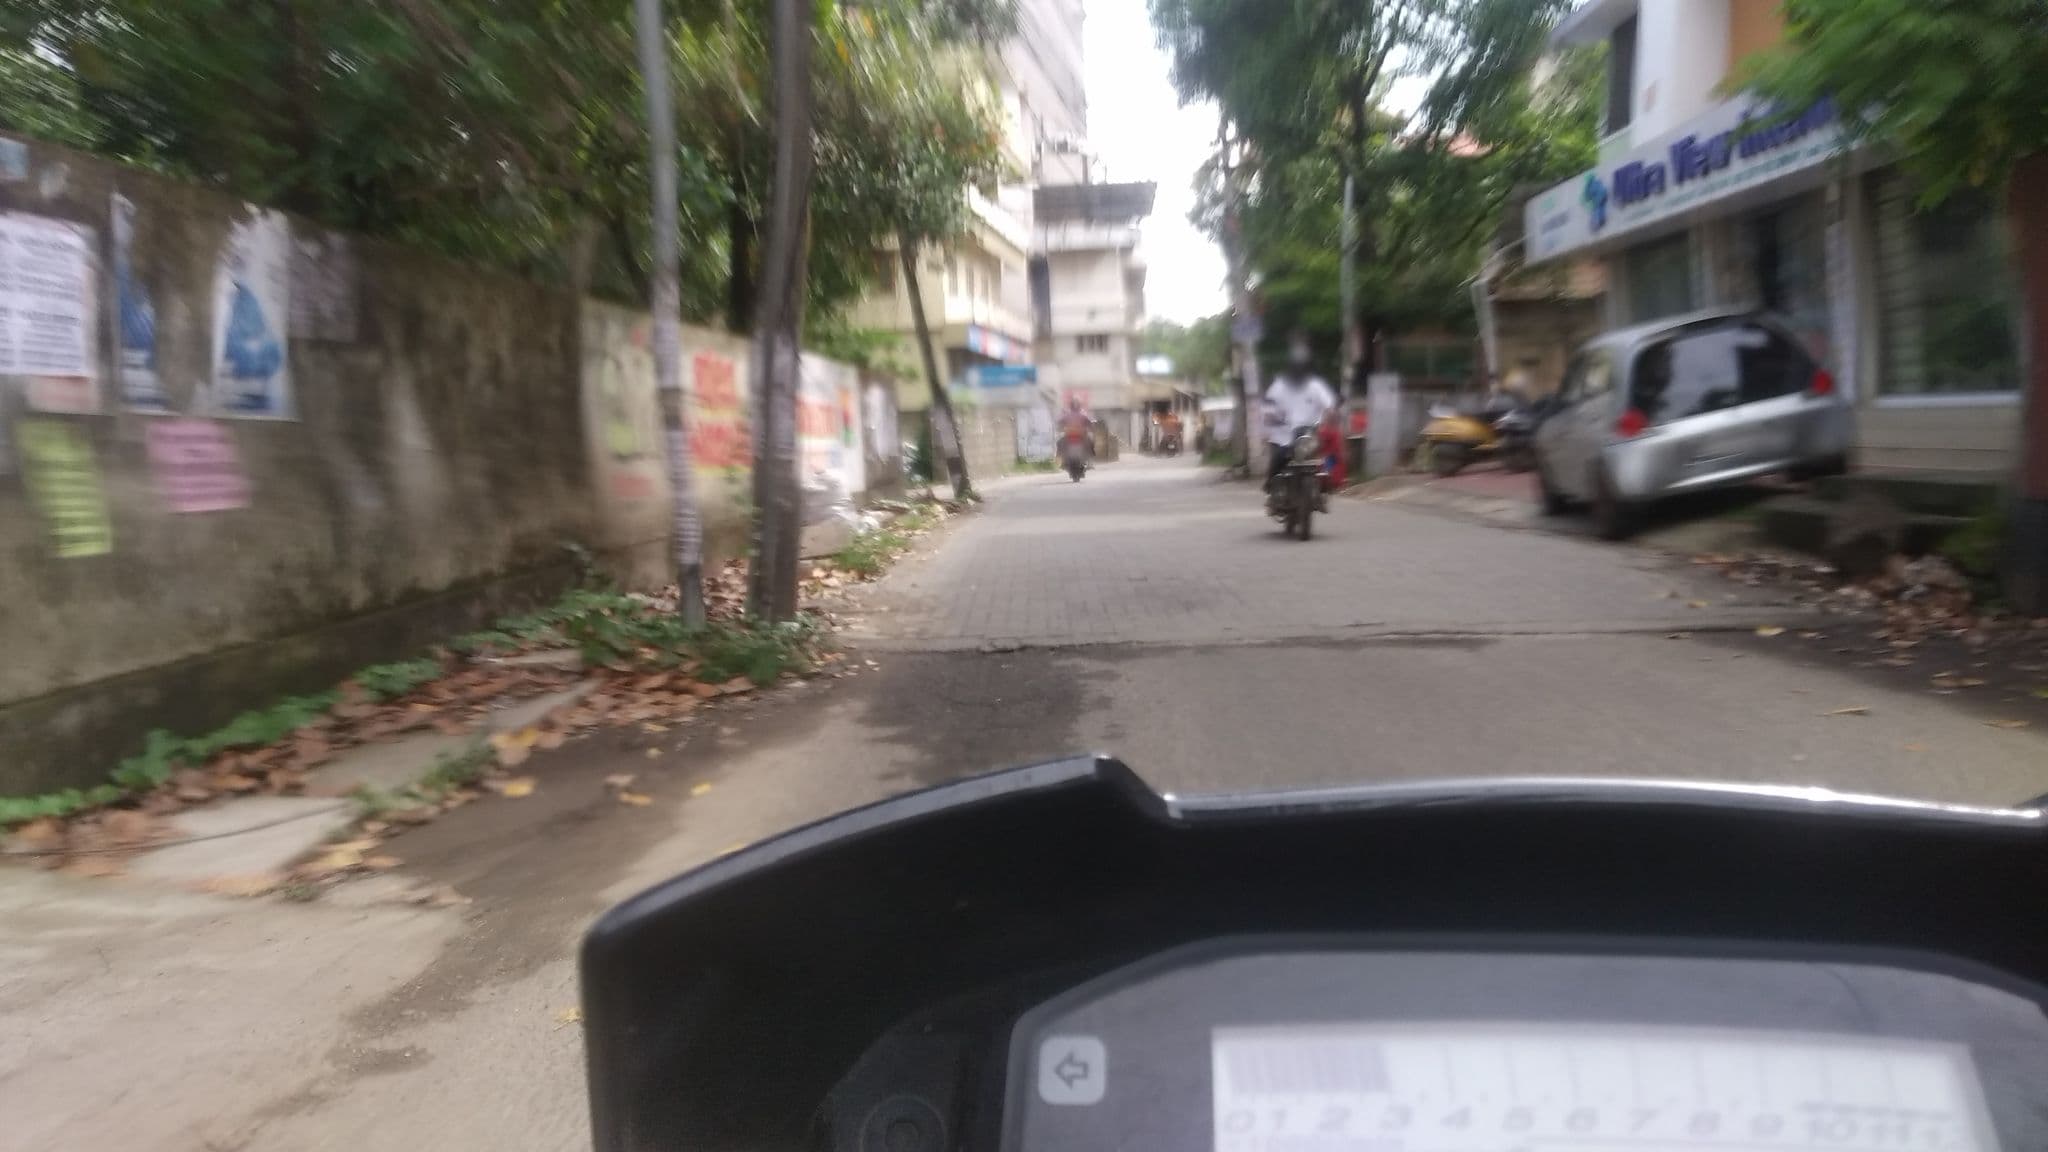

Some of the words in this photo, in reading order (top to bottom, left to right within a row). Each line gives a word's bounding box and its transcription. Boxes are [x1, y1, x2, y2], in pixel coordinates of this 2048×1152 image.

[1316, 1105, 1351, 1132] 2
[1440, 1105, 1473, 1131] 4
[1562, 1106, 1596, 1133] 6
[1629, 1107, 1660, 1133] 7
